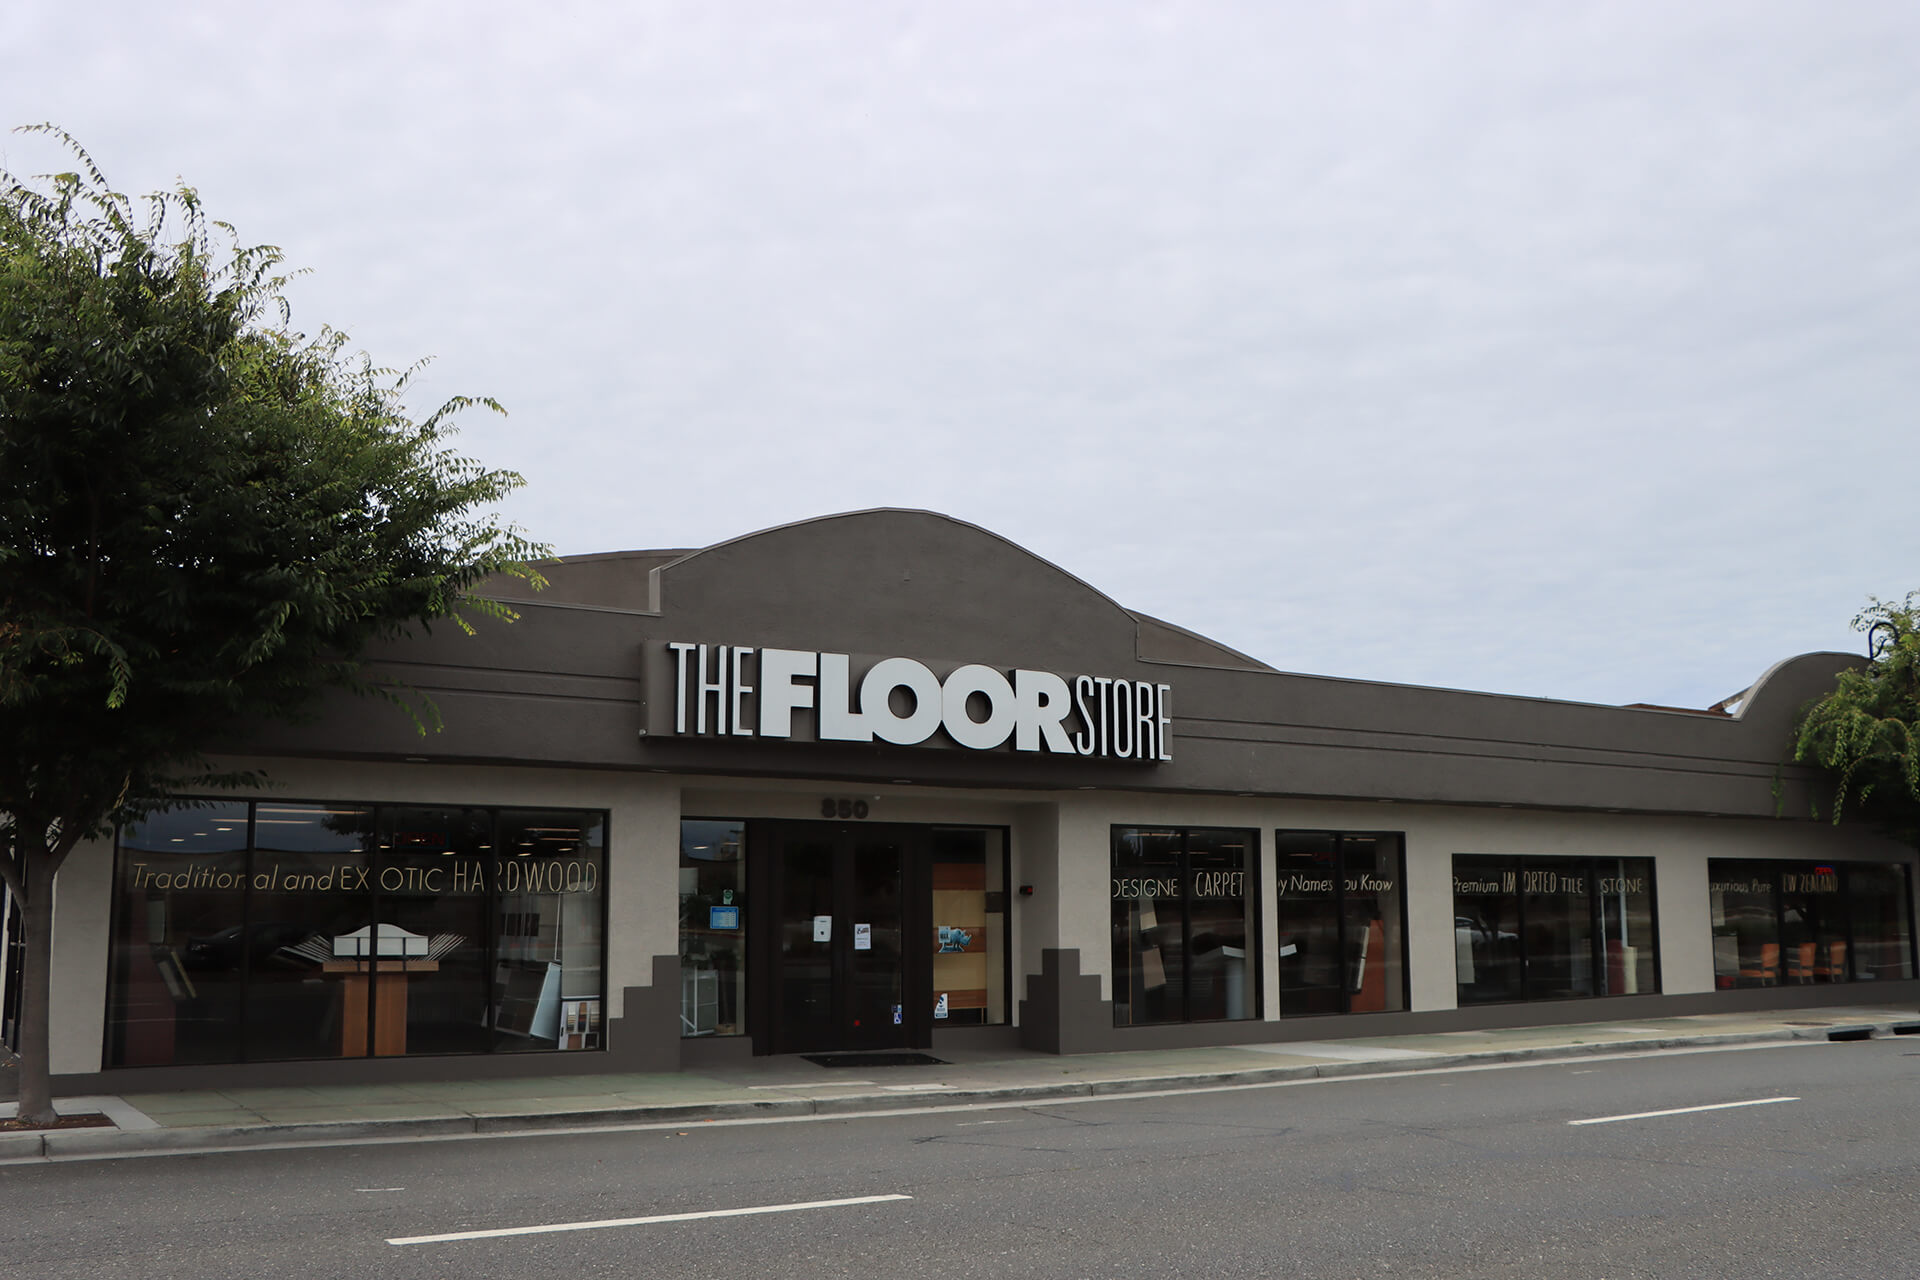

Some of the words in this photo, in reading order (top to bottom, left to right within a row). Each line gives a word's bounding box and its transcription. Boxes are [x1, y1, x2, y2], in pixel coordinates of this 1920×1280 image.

[668, 642, 754, 736] THE
[759, 647, 1077, 754] FLOOR
[1076, 674, 1172, 761] STORE
[821, 797, 869, 819] 850
[133, 863, 279, 890] Traditional
[283, 865, 336, 891] and
[340, 865, 444, 892] EXOTIC
[1112, 877, 1179, 898] DESIGNE
[1195, 871, 1245, 897] CARPET
[1290, 874, 1334, 892] Names
[1344, 879, 1358, 892] ou
[1360, 873, 1393, 892] Know
[1503, 871, 1557, 894] IMORTED
[1560, 877, 1584, 894] TILE
[1601, 877, 1643, 894] STONE
